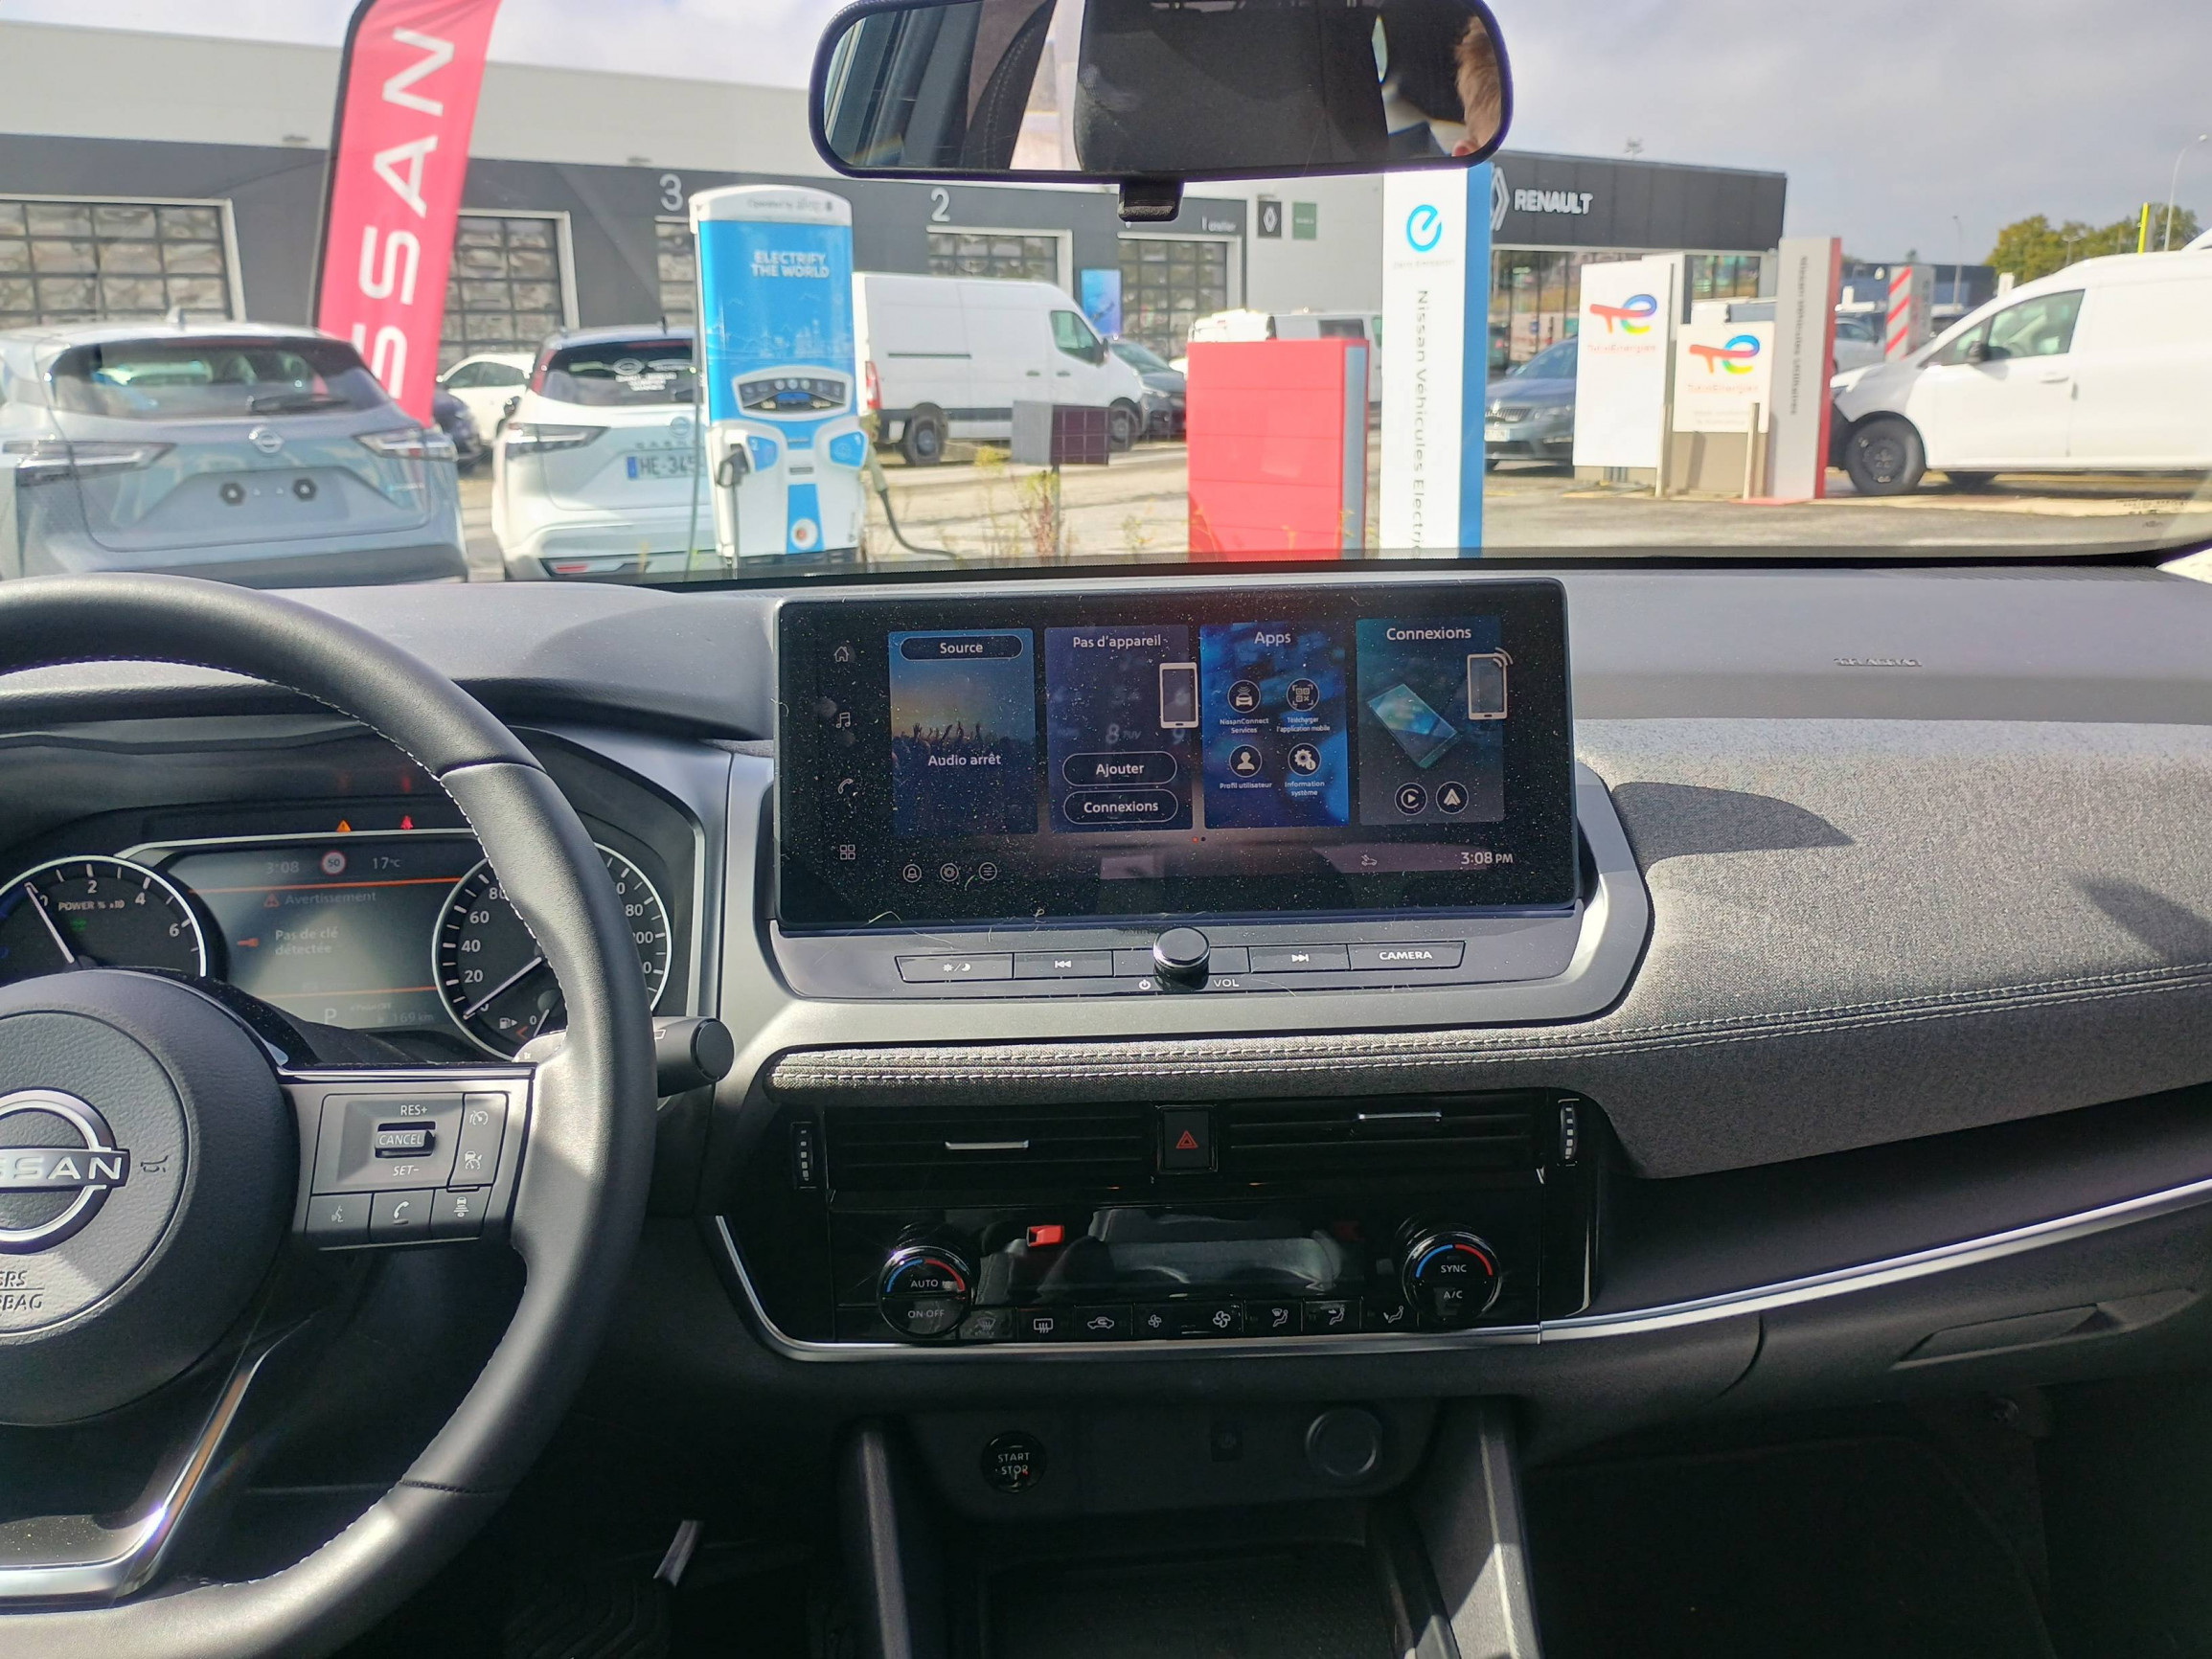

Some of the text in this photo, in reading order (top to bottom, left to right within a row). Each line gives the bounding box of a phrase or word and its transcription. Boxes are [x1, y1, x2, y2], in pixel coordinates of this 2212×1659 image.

[659, 173, 683, 212] 3
[929, 187, 951, 222] 2
[1514, 189, 1594, 215] RENAULT
[753, 250, 826, 265] ELECTRIFY
[750, 263, 831, 279] THE WORLD
[1416, 289, 1428, 363] Nissan
[1254, 631, 1291, 646] Apps
[1386, 627, 1472, 641] Connexions
[939, 641, 984, 655] Source
[1072, 634, 1161, 650] Pas d'appareil
[1220, 717, 1269, 726] NissanConnect
[928, 752, 1002, 767] Audio arrêt
[1095, 761, 1145, 778] Ajouter
[1083, 800, 1159, 814] Connexions
[327, 857, 341, 868] 50
[1460, 851, 1514, 865] 3:08 PM
[265, 861, 300, 875] 3:08
[87, 879, 97, 895] 2
[134, 892, 147, 906] 4
[285, 891, 376, 905] Avertissement
[58, 900, 95, 911] POWER
[469, 910, 490, 924] 60
[169, 922, 180, 938] 6
[275, 925, 339, 941] Pas de clé
[632, 931, 654, 944] 00
[275, 943, 332, 956] détectée
[461, 939, 481, 952] 40
[1379, 949, 1433, 961] CAMERA
[464, 969, 484, 983] 20
[1213, 978, 1240, 989] VOL
[324, 1008, 337, 1026] P
[529, 1015, 537, 1025] 0
[400, 1103, 429, 1117] RES+
[378, 1133, 422, 1147] CANCEL
[0, 1156, 123, 1181] SAN
[1440, 1264, 1468, 1273] SYNC
[910, 1279, 939, 1288] AUTO
[1443, 1290, 1463, 1299] A/C
[0, 1294, 44, 1311] BAG
[997, 1452, 1031, 1464] START
